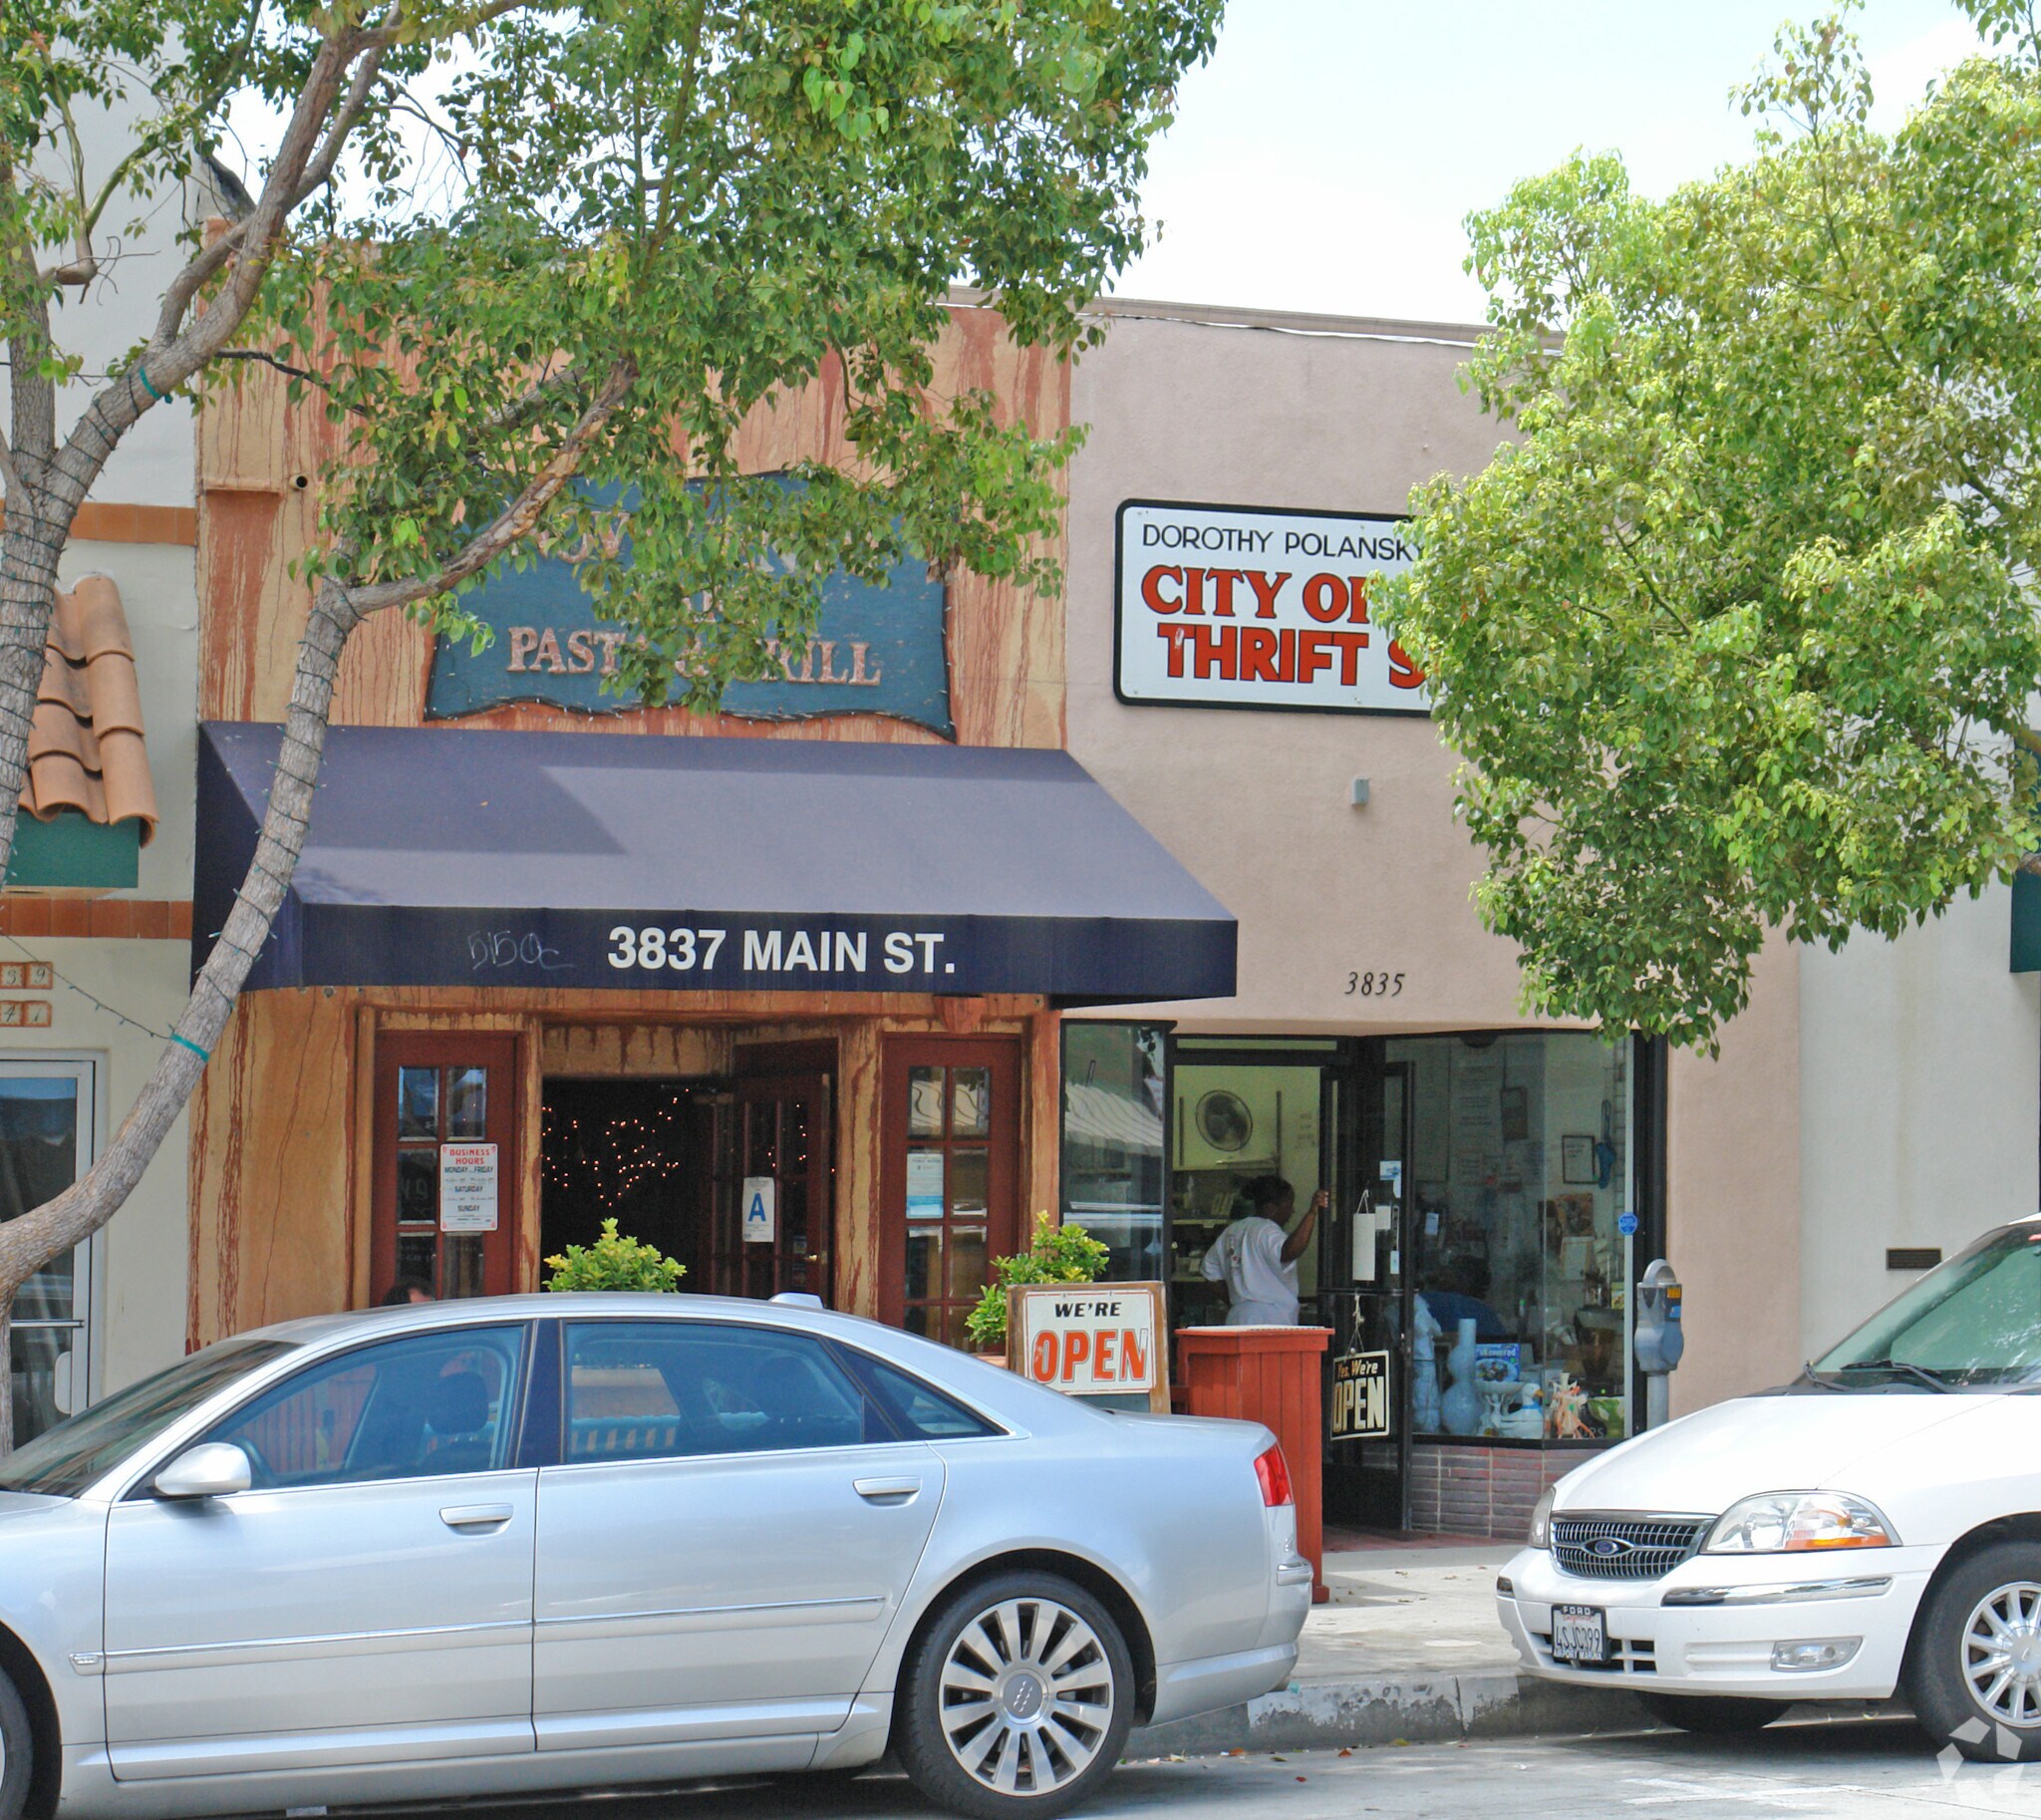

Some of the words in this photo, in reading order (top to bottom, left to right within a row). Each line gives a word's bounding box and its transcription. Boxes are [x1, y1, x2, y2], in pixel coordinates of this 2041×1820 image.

[1143, 524, 1273, 552] DOROTHY
[1141, 564, 1292, 619] CITY
[1157, 623, 1368, 686] THRIFT
[608, 927, 727, 970] 3837
[743, 930, 867, 972] MAIN
[883, 932, 955, 974] ST.
[1344, 971, 1406, 997] 3835
[748, 1192, 766, 1222] A
[1054, 1302, 1122, 1318] WE'RE
[1031, 1329, 1149, 1384] OPEN
[1332, 1376, 1384, 1433] OPEN
[1563, 1606, 1592, 1615] FORD
